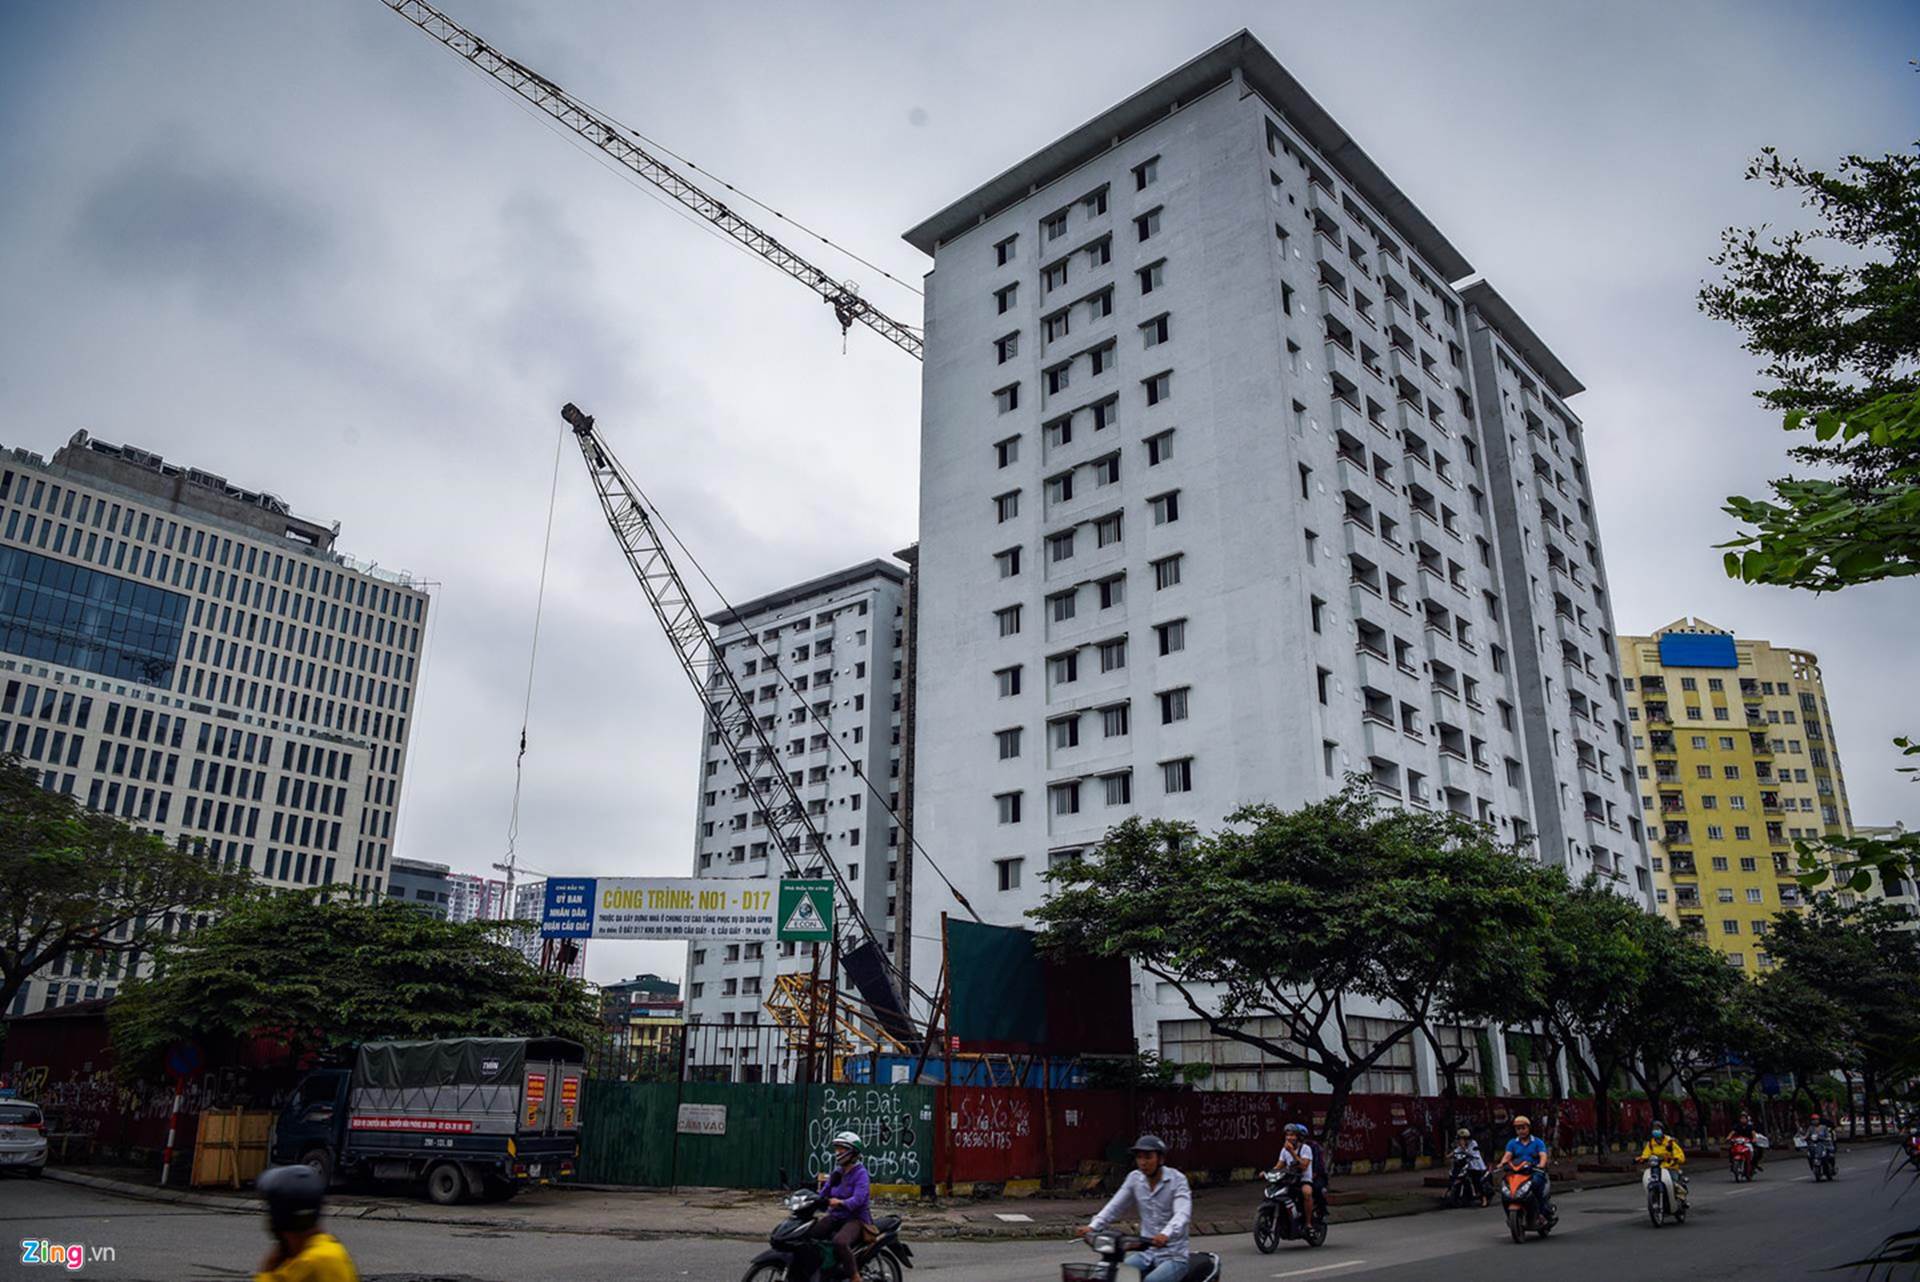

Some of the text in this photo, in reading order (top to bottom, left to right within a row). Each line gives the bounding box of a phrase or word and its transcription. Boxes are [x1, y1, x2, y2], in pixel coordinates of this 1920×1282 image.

[567, 895, 583, 904] BAN
[602, 886, 644, 909] CÔNG
[742, 890, 771, 910] D17
